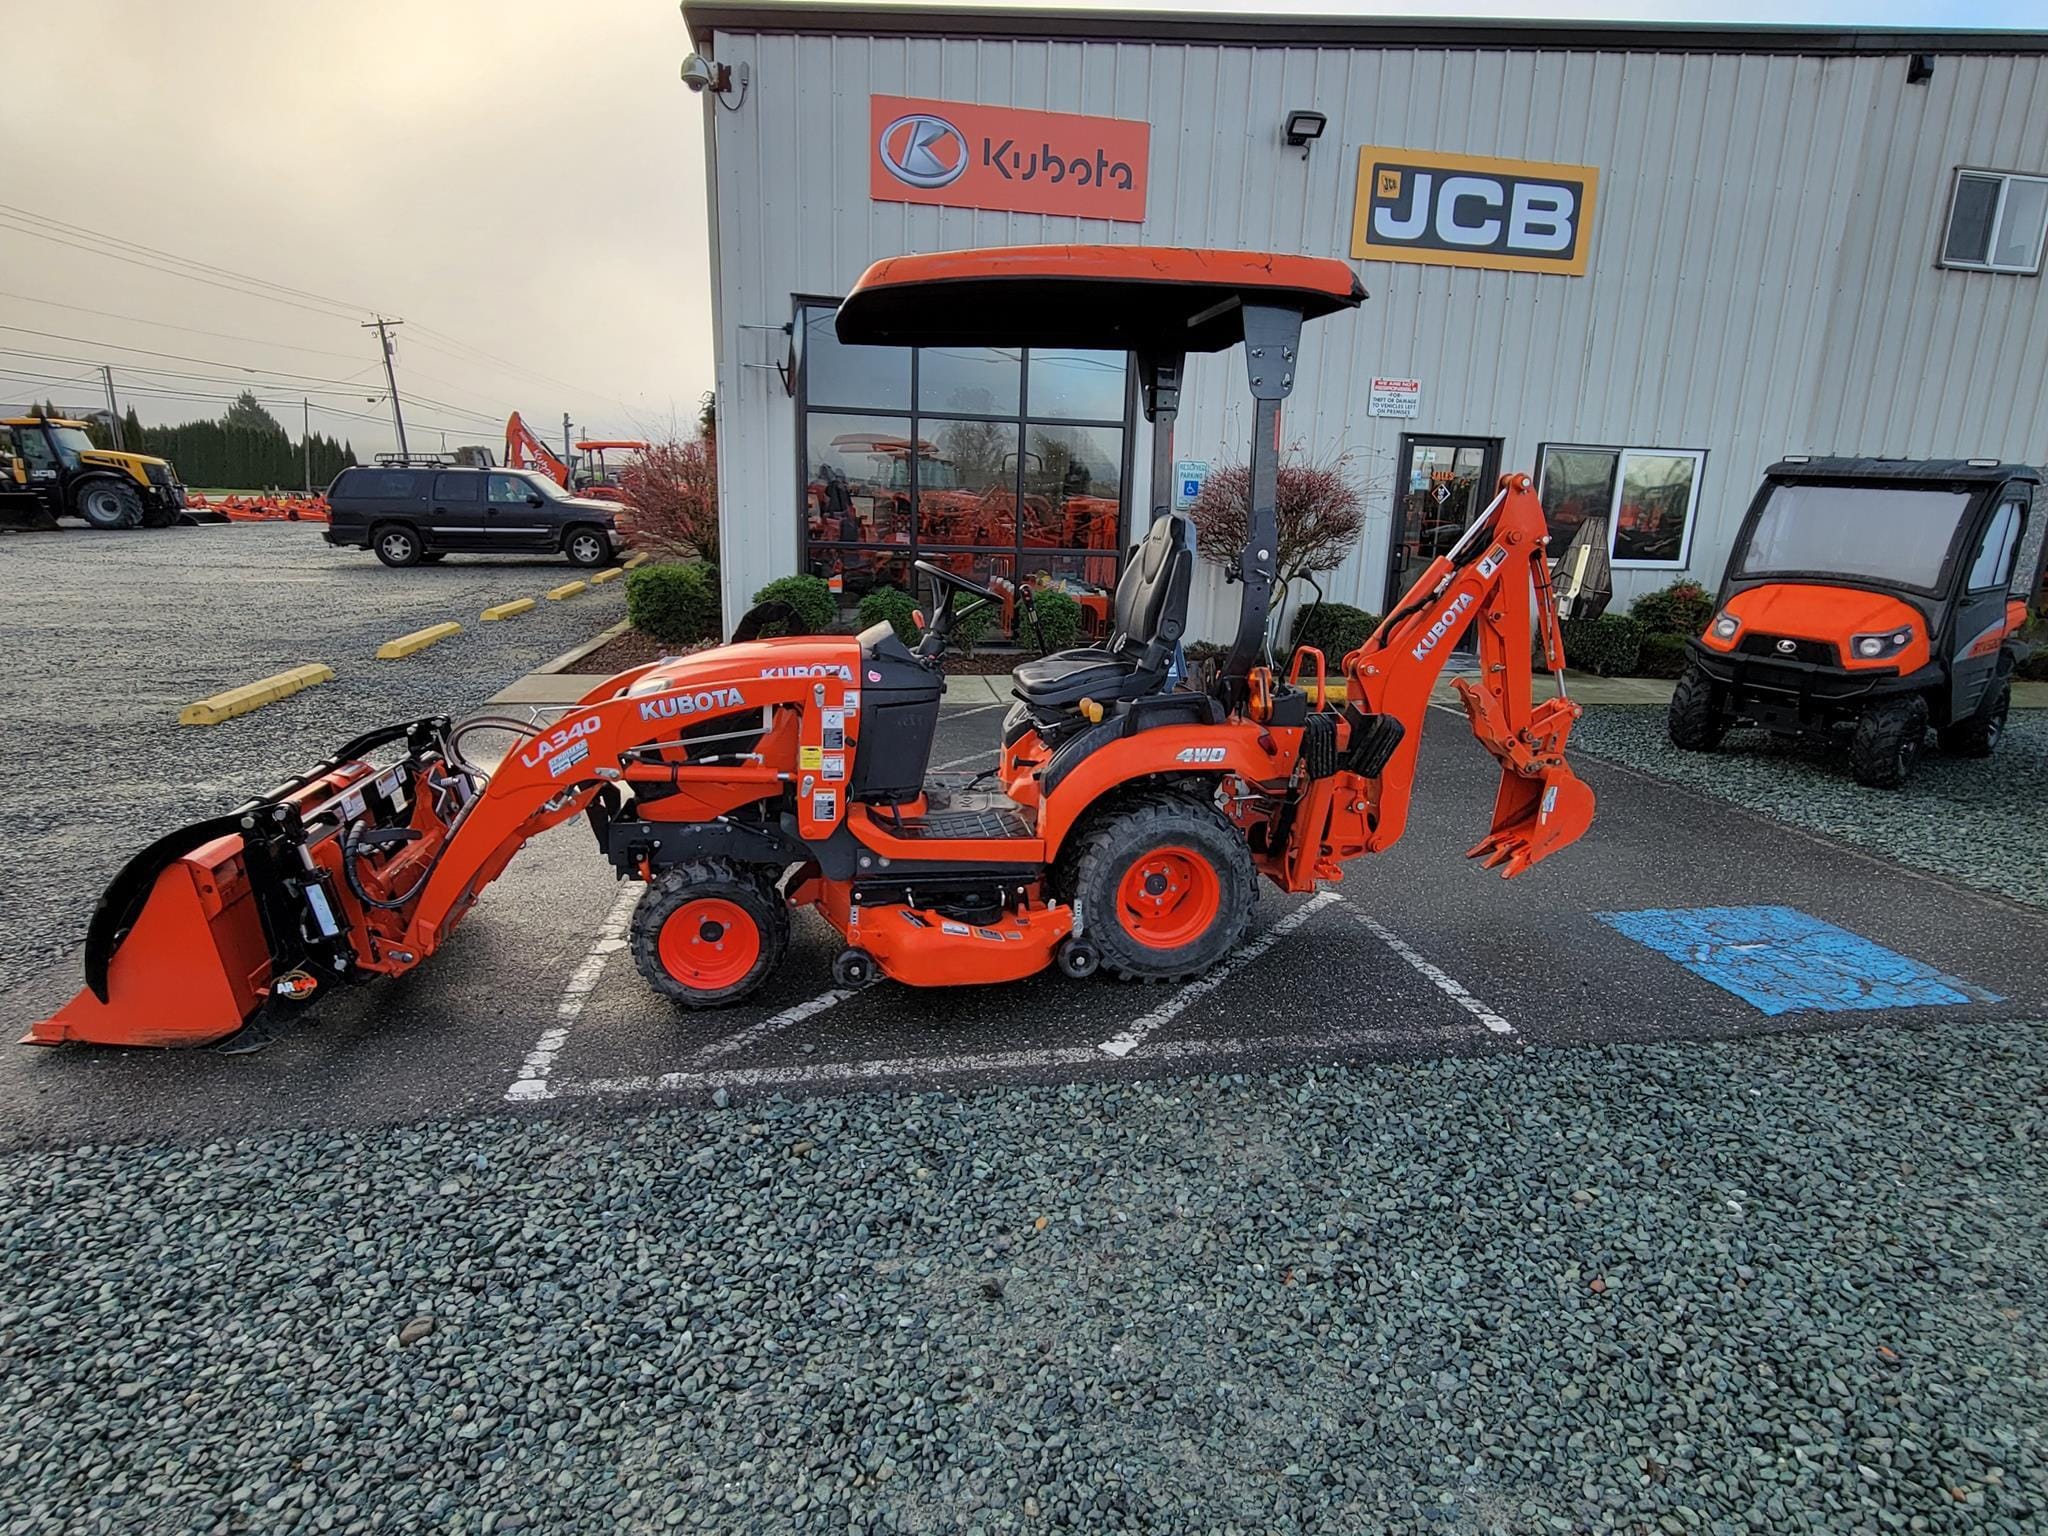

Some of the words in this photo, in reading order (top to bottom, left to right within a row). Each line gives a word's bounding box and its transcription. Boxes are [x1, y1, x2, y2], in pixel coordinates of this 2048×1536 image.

[983, 137, 1133, 189] Kubota
[1374, 173, 1575, 251] JCB
[31, 469, 57, 479] JCB
[1180, 471, 1203, 479] PARKING
[1432, 471, 1456, 481] SALES
[1412, 592, 1475, 661] KUBOTA
[639, 687, 745, 721] KUBOTA
[521, 715, 602, 768] LA340
[1176, 747, 1226, 762] 4WD
